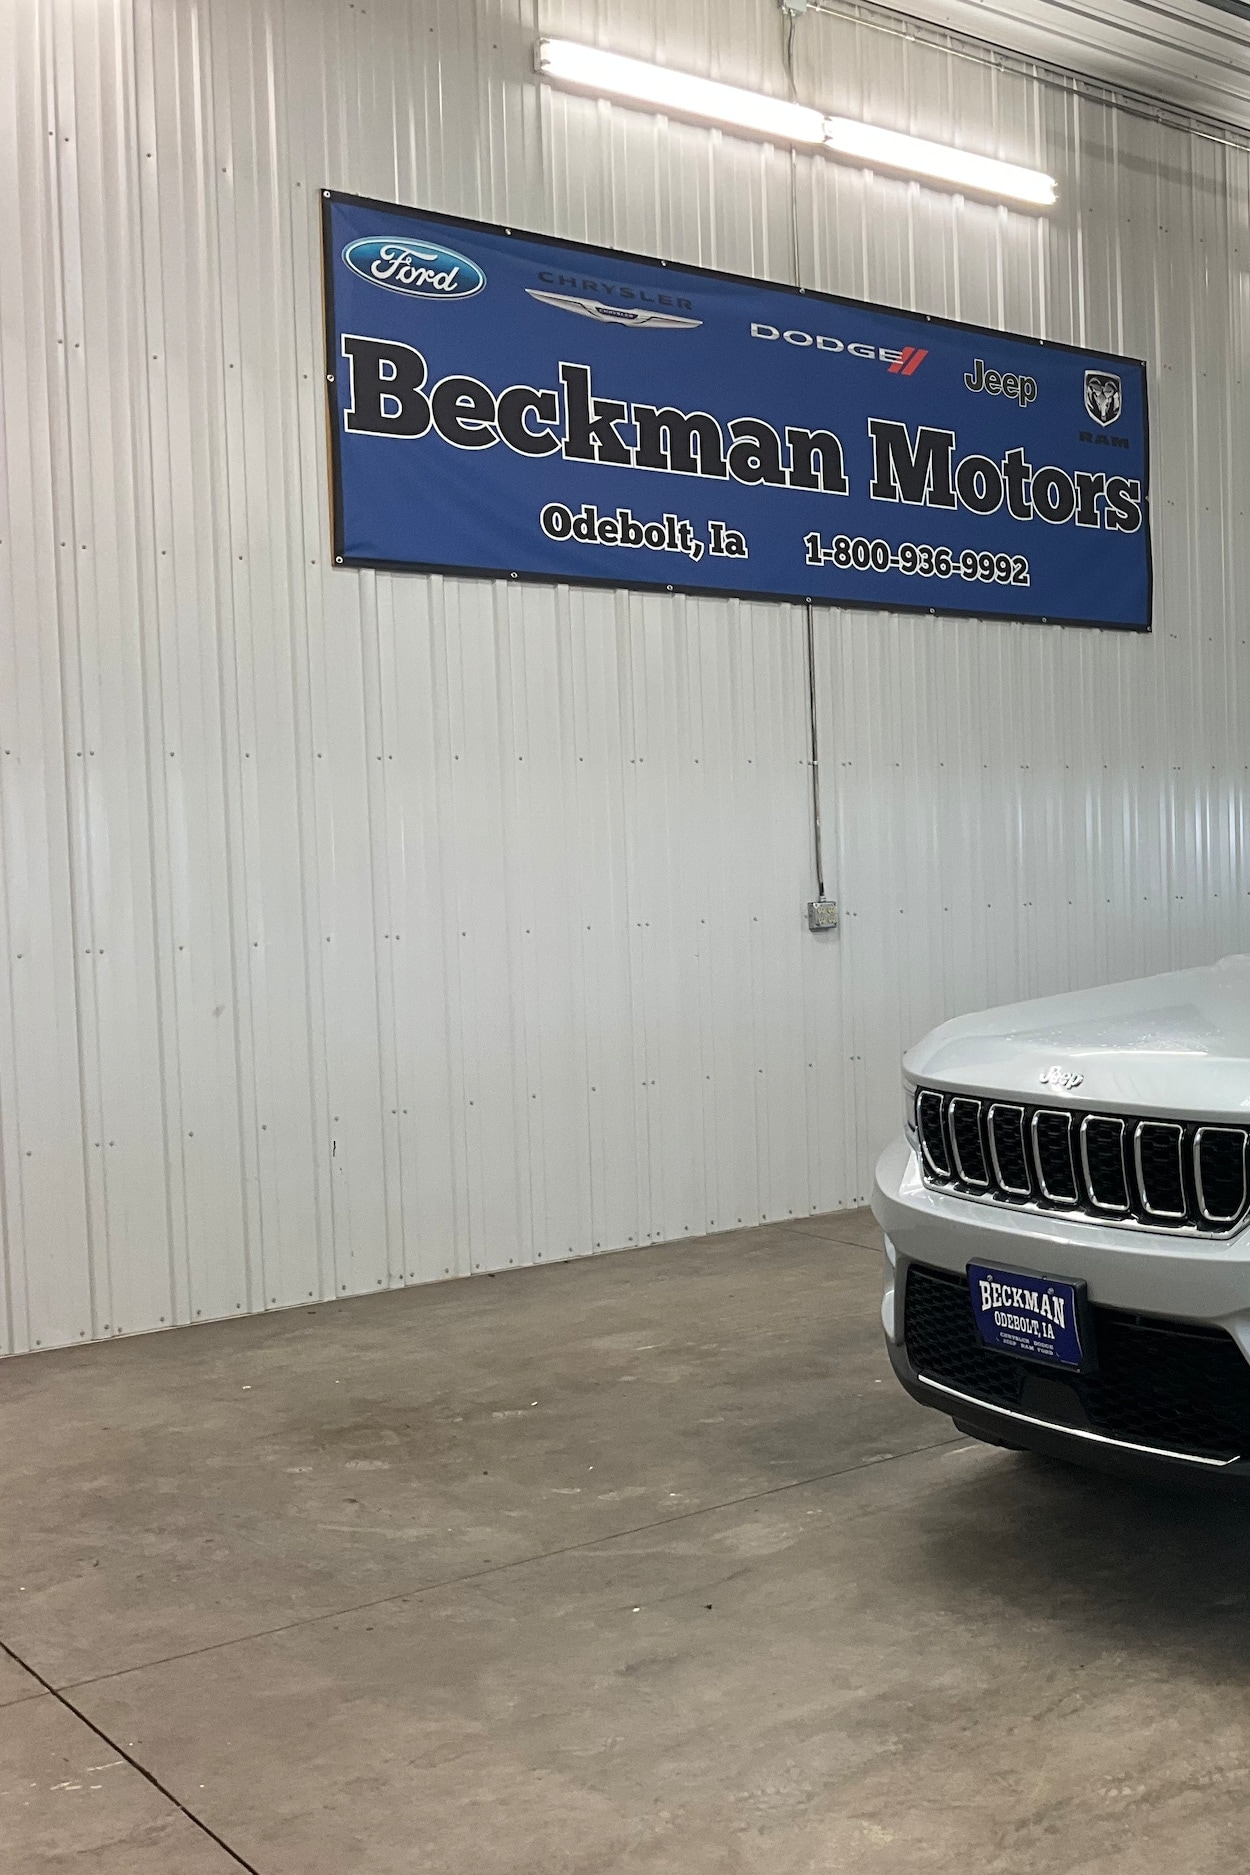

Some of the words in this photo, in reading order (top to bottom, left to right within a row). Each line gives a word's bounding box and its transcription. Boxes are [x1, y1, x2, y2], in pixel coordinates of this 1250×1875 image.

[370, 243, 458, 292] Ford
[537, 271, 693, 311] CHRYSLER
[750, 322, 903, 365] DODGE
[964, 359, 1037, 407] Jeep
[341, 333, 849, 496] Beckman
[867, 417, 1142, 534] Motors
[1078, 430, 1130, 449] RAM
[540, 502, 705, 562] Odebolt,
[708, 520, 748, 559] Ia
[804, 532, 1031, 587] 1-800-936-9992
[1039, 1065, 1084, 1090] Jeep
[979, 1280, 1065, 1329] BECKMAN
[994, 1310, 1041, 1338] ODEBOLT,
[1041, 1322, 1055, 1339] IA
